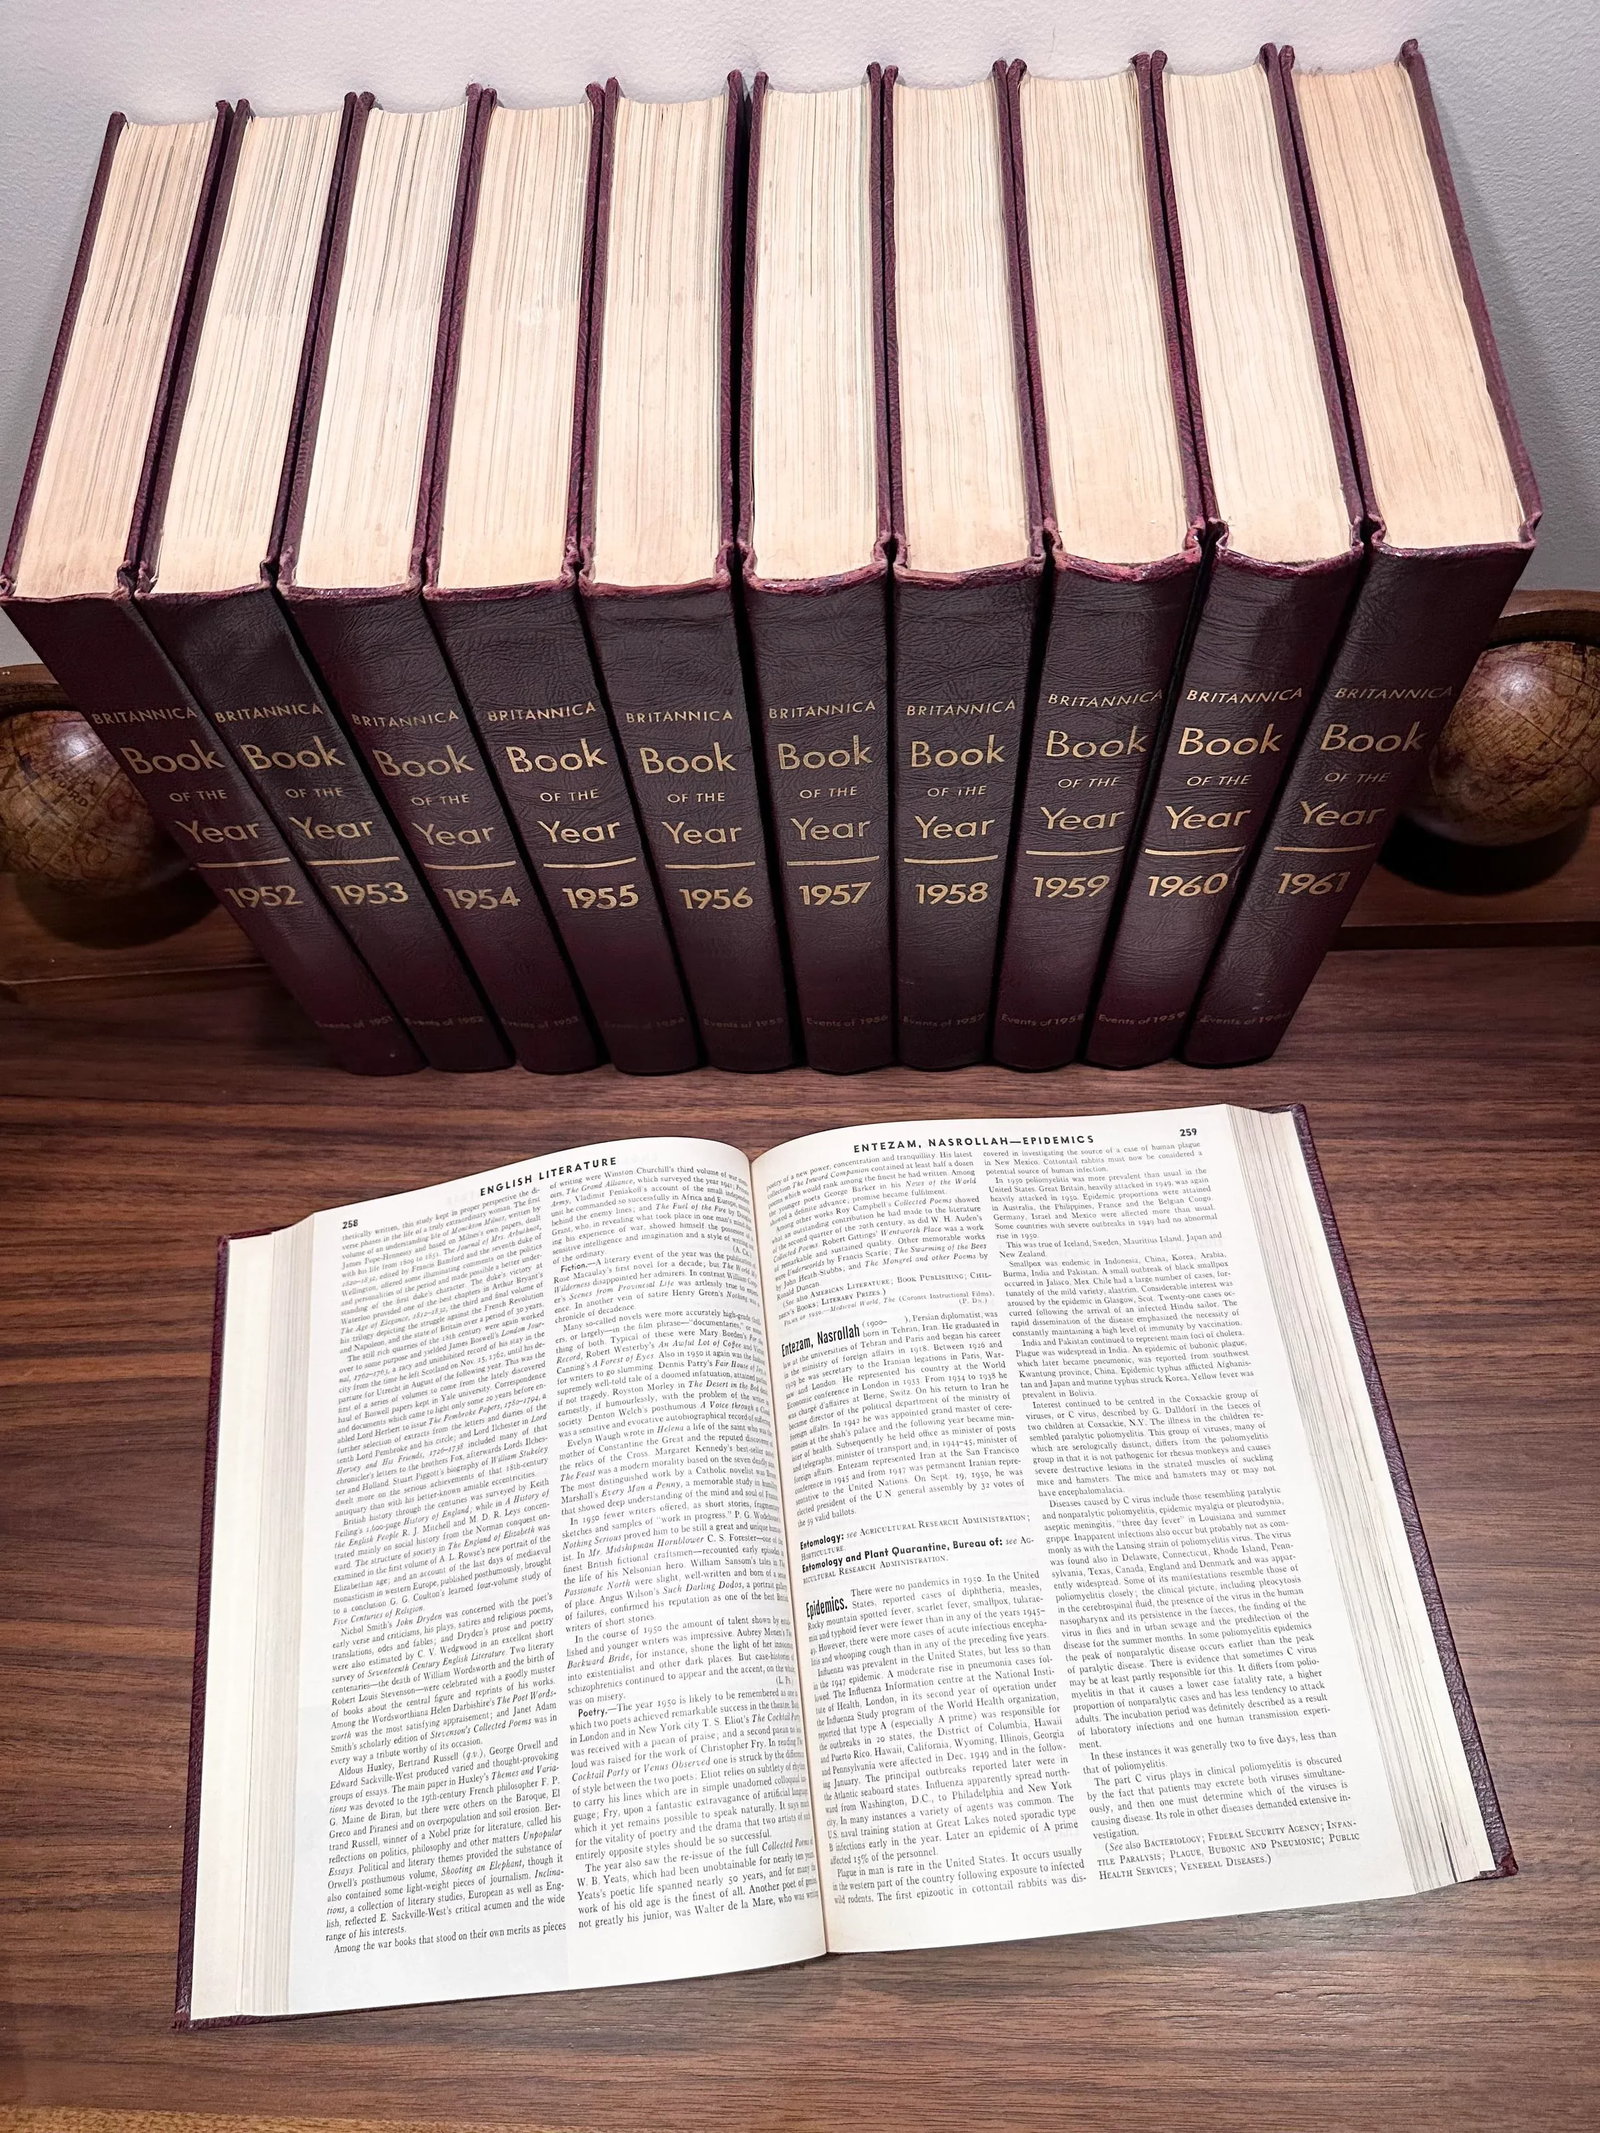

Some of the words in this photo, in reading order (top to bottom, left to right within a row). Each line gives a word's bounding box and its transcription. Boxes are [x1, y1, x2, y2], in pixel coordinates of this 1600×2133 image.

[1047, 687, 1163, 708] BRITANNICA
[1186, 687, 1302, 704] BRITANNICA
[1333, 686, 1454, 702] BRITANNICA
[91, 706, 198, 727] BRITANNICA
[213, 701, 324, 723] BRITANNICA
[351, 709, 460, 728] BRITANNICA
[487, 700, 597, 722] BRITANNICA
[625, 709, 733, 724] BRITANNICA
[768, 699, 876, 720] BRITANNICA
[906, 699, 1016, 716] BRITANNICA
[1045, 725, 1149, 758] Book
[1177, 723, 1283, 756] Book
[1319, 721, 1430, 753] Book
[119, 739, 226, 774] Book
[239, 732, 346, 770] Book
[372, 744, 475, 777] Book
[505, 737, 608, 773] Book
[639, 741, 737, 774] Book
[777, 734, 873, 770] Book
[911, 734, 1005, 768] Book
[1057, 778, 1083, 789] OF
[1088, 776, 1121, 788] THE
[1186, 775, 1213, 787] OF
[1218, 774, 1252, 786] THE
[1324, 772, 1350, 783] OF
[1355, 772, 1391, 785] THE
[169, 792, 191, 802] OF
[196, 789, 228, 800] THE
[285, 788, 307, 799] OF
[312, 787, 343, 798] THE
[410, 796, 433, 806] OF
[439, 793, 470, 805] THE
[539, 792, 561, 802] OF
[567, 788, 600, 802] THE
[666, 793, 689, 804] OF
[695, 792, 725, 803] THE
[799, 788, 822, 799] OF
[828, 785, 858, 798] THE
[927, 787, 950, 798] OF
[957, 785, 987, 797] THE
[1040, 806, 1126, 830] Year
[1164, 805, 1252, 830] Year
[1300, 800, 1385, 826] Year
[175, 820, 259, 844] Year
[288, 816, 373, 840] Year
[411, 822, 495, 846] Year
[536, 820, 621, 844] Year
[660, 821, 743, 845] Year
[789, 817, 871, 841] Year
[914, 815, 996, 839] Year
[330, 881, 409, 905] 1953
[798, 881, 872, 906] 1957
[914, 881, 989, 905] 1958
[1032, 874, 1111, 899] 1959
[1147, 872, 1229, 898] 1960
[1277, 871, 1349, 895] 1961
[224, 885, 304, 908] 1952
[442, 886, 521, 910] 1954
[561, 883, 639, 910] 1955
[678, 886, 754, 910] 1956
[1001, 1013, 1038, 1027] Events
[1098, 1013, 1137, 1026] Events
[1138, 1015, 1152, 1026] of
[853, 1139, 922, 1153] ENTEZAM,
[927, 1134, 1094, 1147] NASROLLAH—EPIDEMICS
[1178, 1127, 1197, 1137] 259
[480, 1173, 532, 1197] ENGLISH
[539, 1157, 617, 1180] LITERATURE
[341, 1218, 359, 1230] 258
[781, 1337, 814, 1358] Entezam,
[816, 1323, 860, 1345] Nasrollah
[799, 1533, 844, 1551] Entomology:
[801, 1556, 843, 1574] Entomology
[845, 1551, 862, 1563] and
[863, 1547, 889, 1560] Plant
[891, 1541, 950, 1557] Quarantine,
[952, 1539, 987, 1549] Bureau
[988, 1536, 1003, 1547] of:
[805, 1597, 848, 1620] Epidemics.
[634, 1701, 653, 1712] year
[657, 1698, 677, 1709] 1950
[688, 1692, 712, 1704] likely
[714, 1693, 724, 1701] to
[725, 1690, 736, 1700] be
[737, 1687, 780, 1699] remembered
[1089, 1751, 1100, 1761] In
[1102, 1750, 1123, 1760] these
[1125, 1747, 1162, 1758] instances
[1163, 1744, 1171, 1755] it
[1172, 1745, 1189, 1753] was
[1190, 1739, 1227, 1754] generally
[1229, 1739, 1245, 1748] two
[1247, 1738, 1257, 1747] to
[1258, 1735, 1275, 1745] five
[1276, 1733, 1298, 1745] days,
[1299, 1731, 1316, 1741] less
[1317, 1729, 1337, 1739] than
[577, 1918, 592, 1929] not
[594, 1914, 624, 1929] greatly
[626, 1912, 640, 1923] his
[642, 1909, 672, 1923] junior,
[673, 1908, 691, 1917] was
[693, 1903, 725, 1915] Walter
[727, 1900, 738, 1911] de
[740, 1898, 749, 1909] la
[751, 1896, 776, 1908] Mare,
[777, 1892, 793, 1904] who
[333, 1943, 361, 1954] Among
[362, 1940, 375, 1951] the
[377, 1940, 392, 1949] war
[393, 1935, 417, 1947] books
[418, 1934, 434, 1945] that
[435, 1930, 457, 1943] stood
[457, 1932, 468, 1941] on
[469, 1927, 488, 1940] their
[488, 1928, 505, 1938] own
[505, 1923, 531, 1936] merits
[531, 1924, 541, 1933] as
[542, 1920, 567, 1935] pieces
